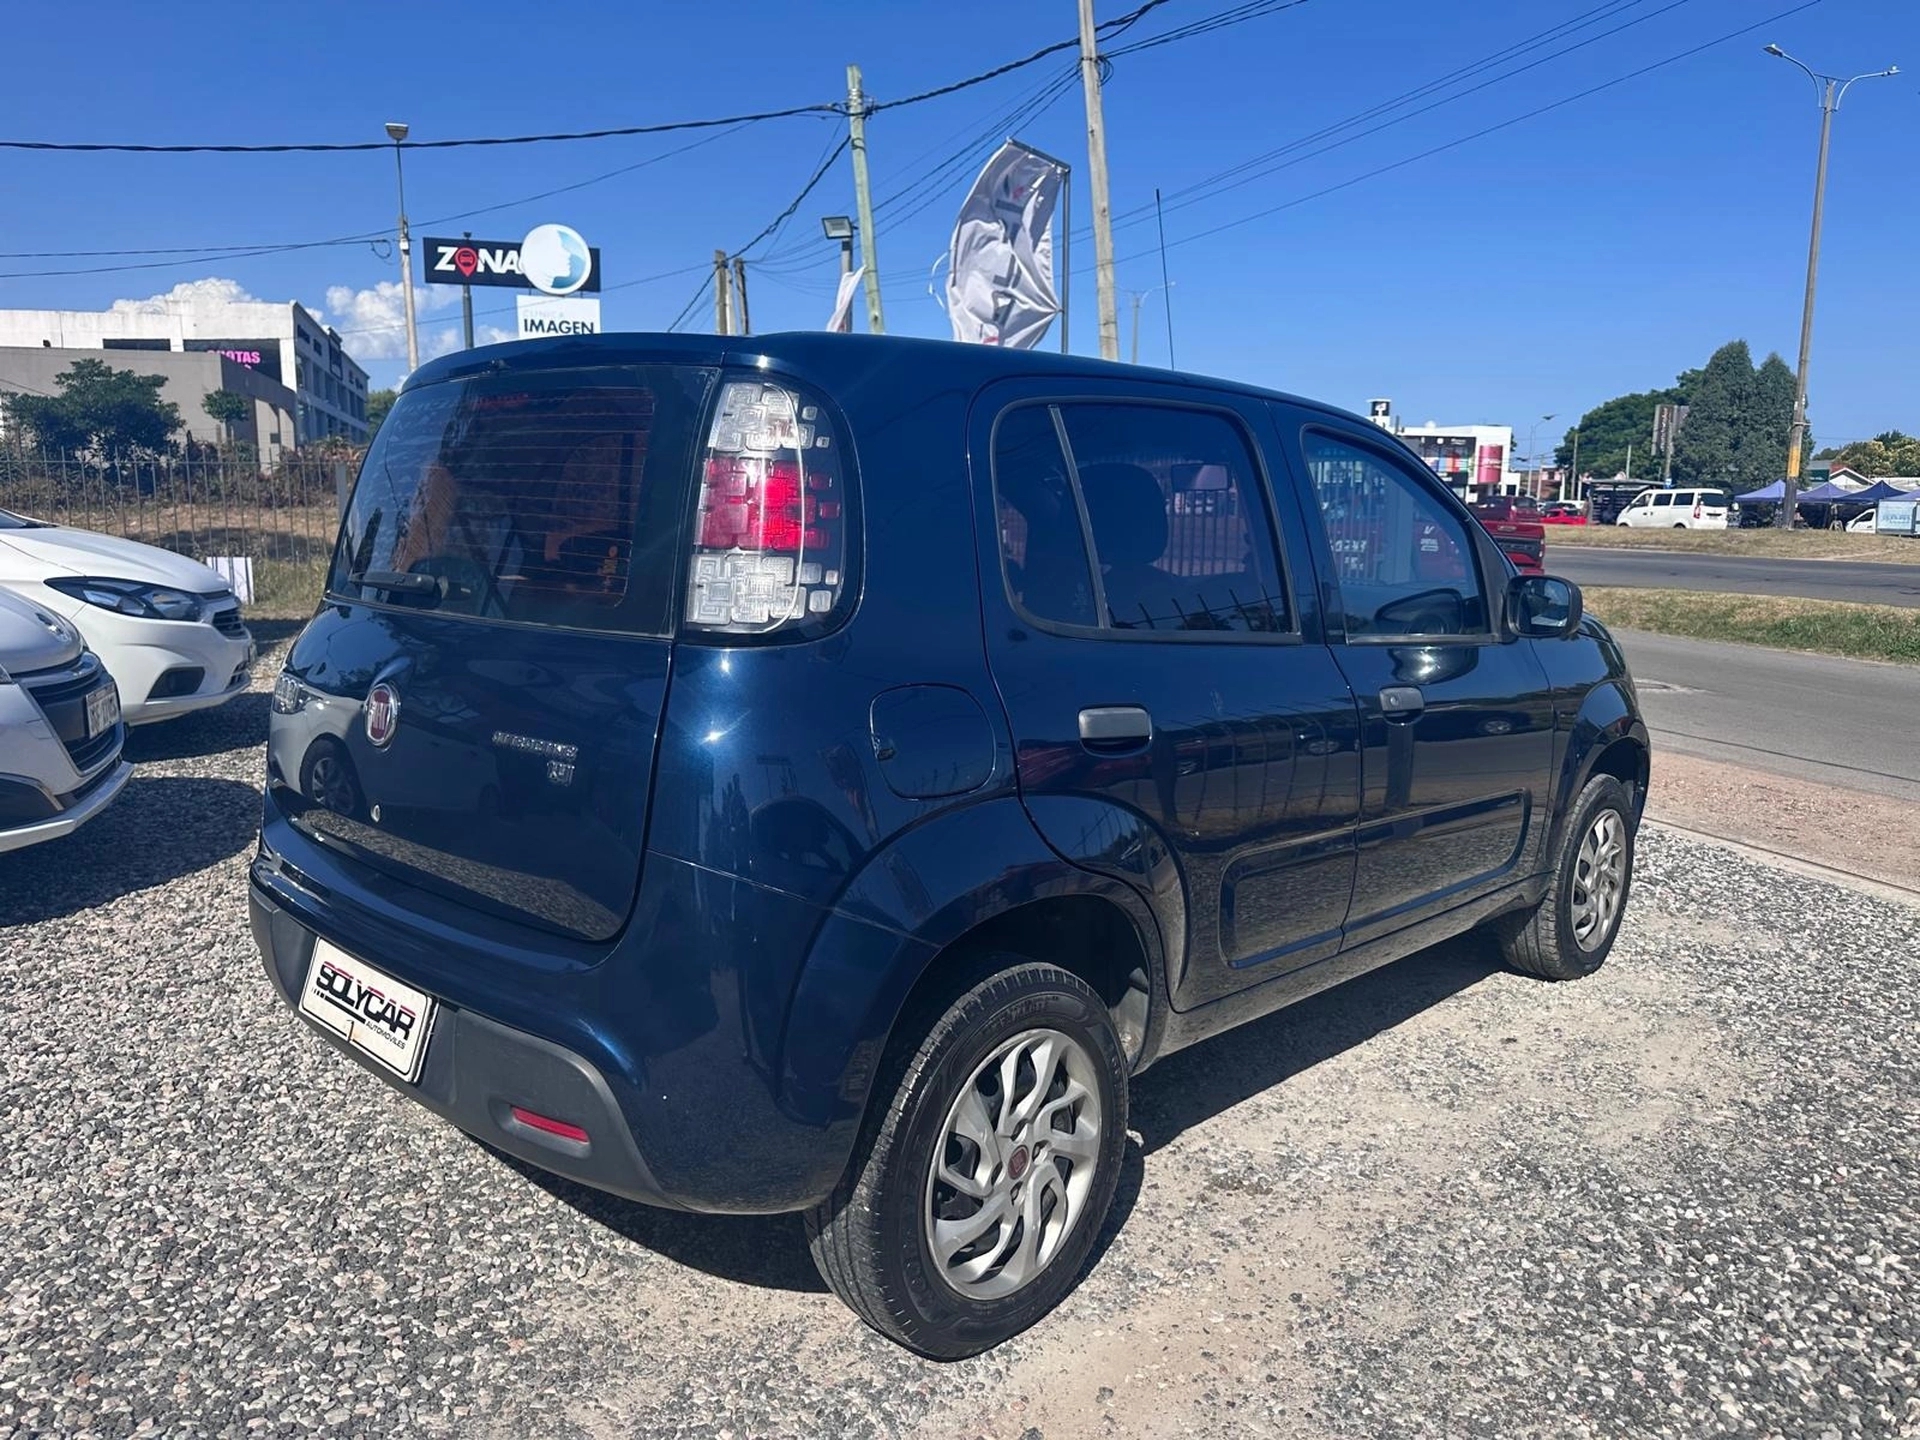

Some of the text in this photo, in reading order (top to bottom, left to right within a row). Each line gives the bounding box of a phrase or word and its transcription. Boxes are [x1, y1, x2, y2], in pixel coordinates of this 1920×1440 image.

[523, 318, 594, 335] IMAGEN
[315, 960, 416, 1041] SOLYCAR
[365, 1021, 407, 1051] AUTOMOVILES
